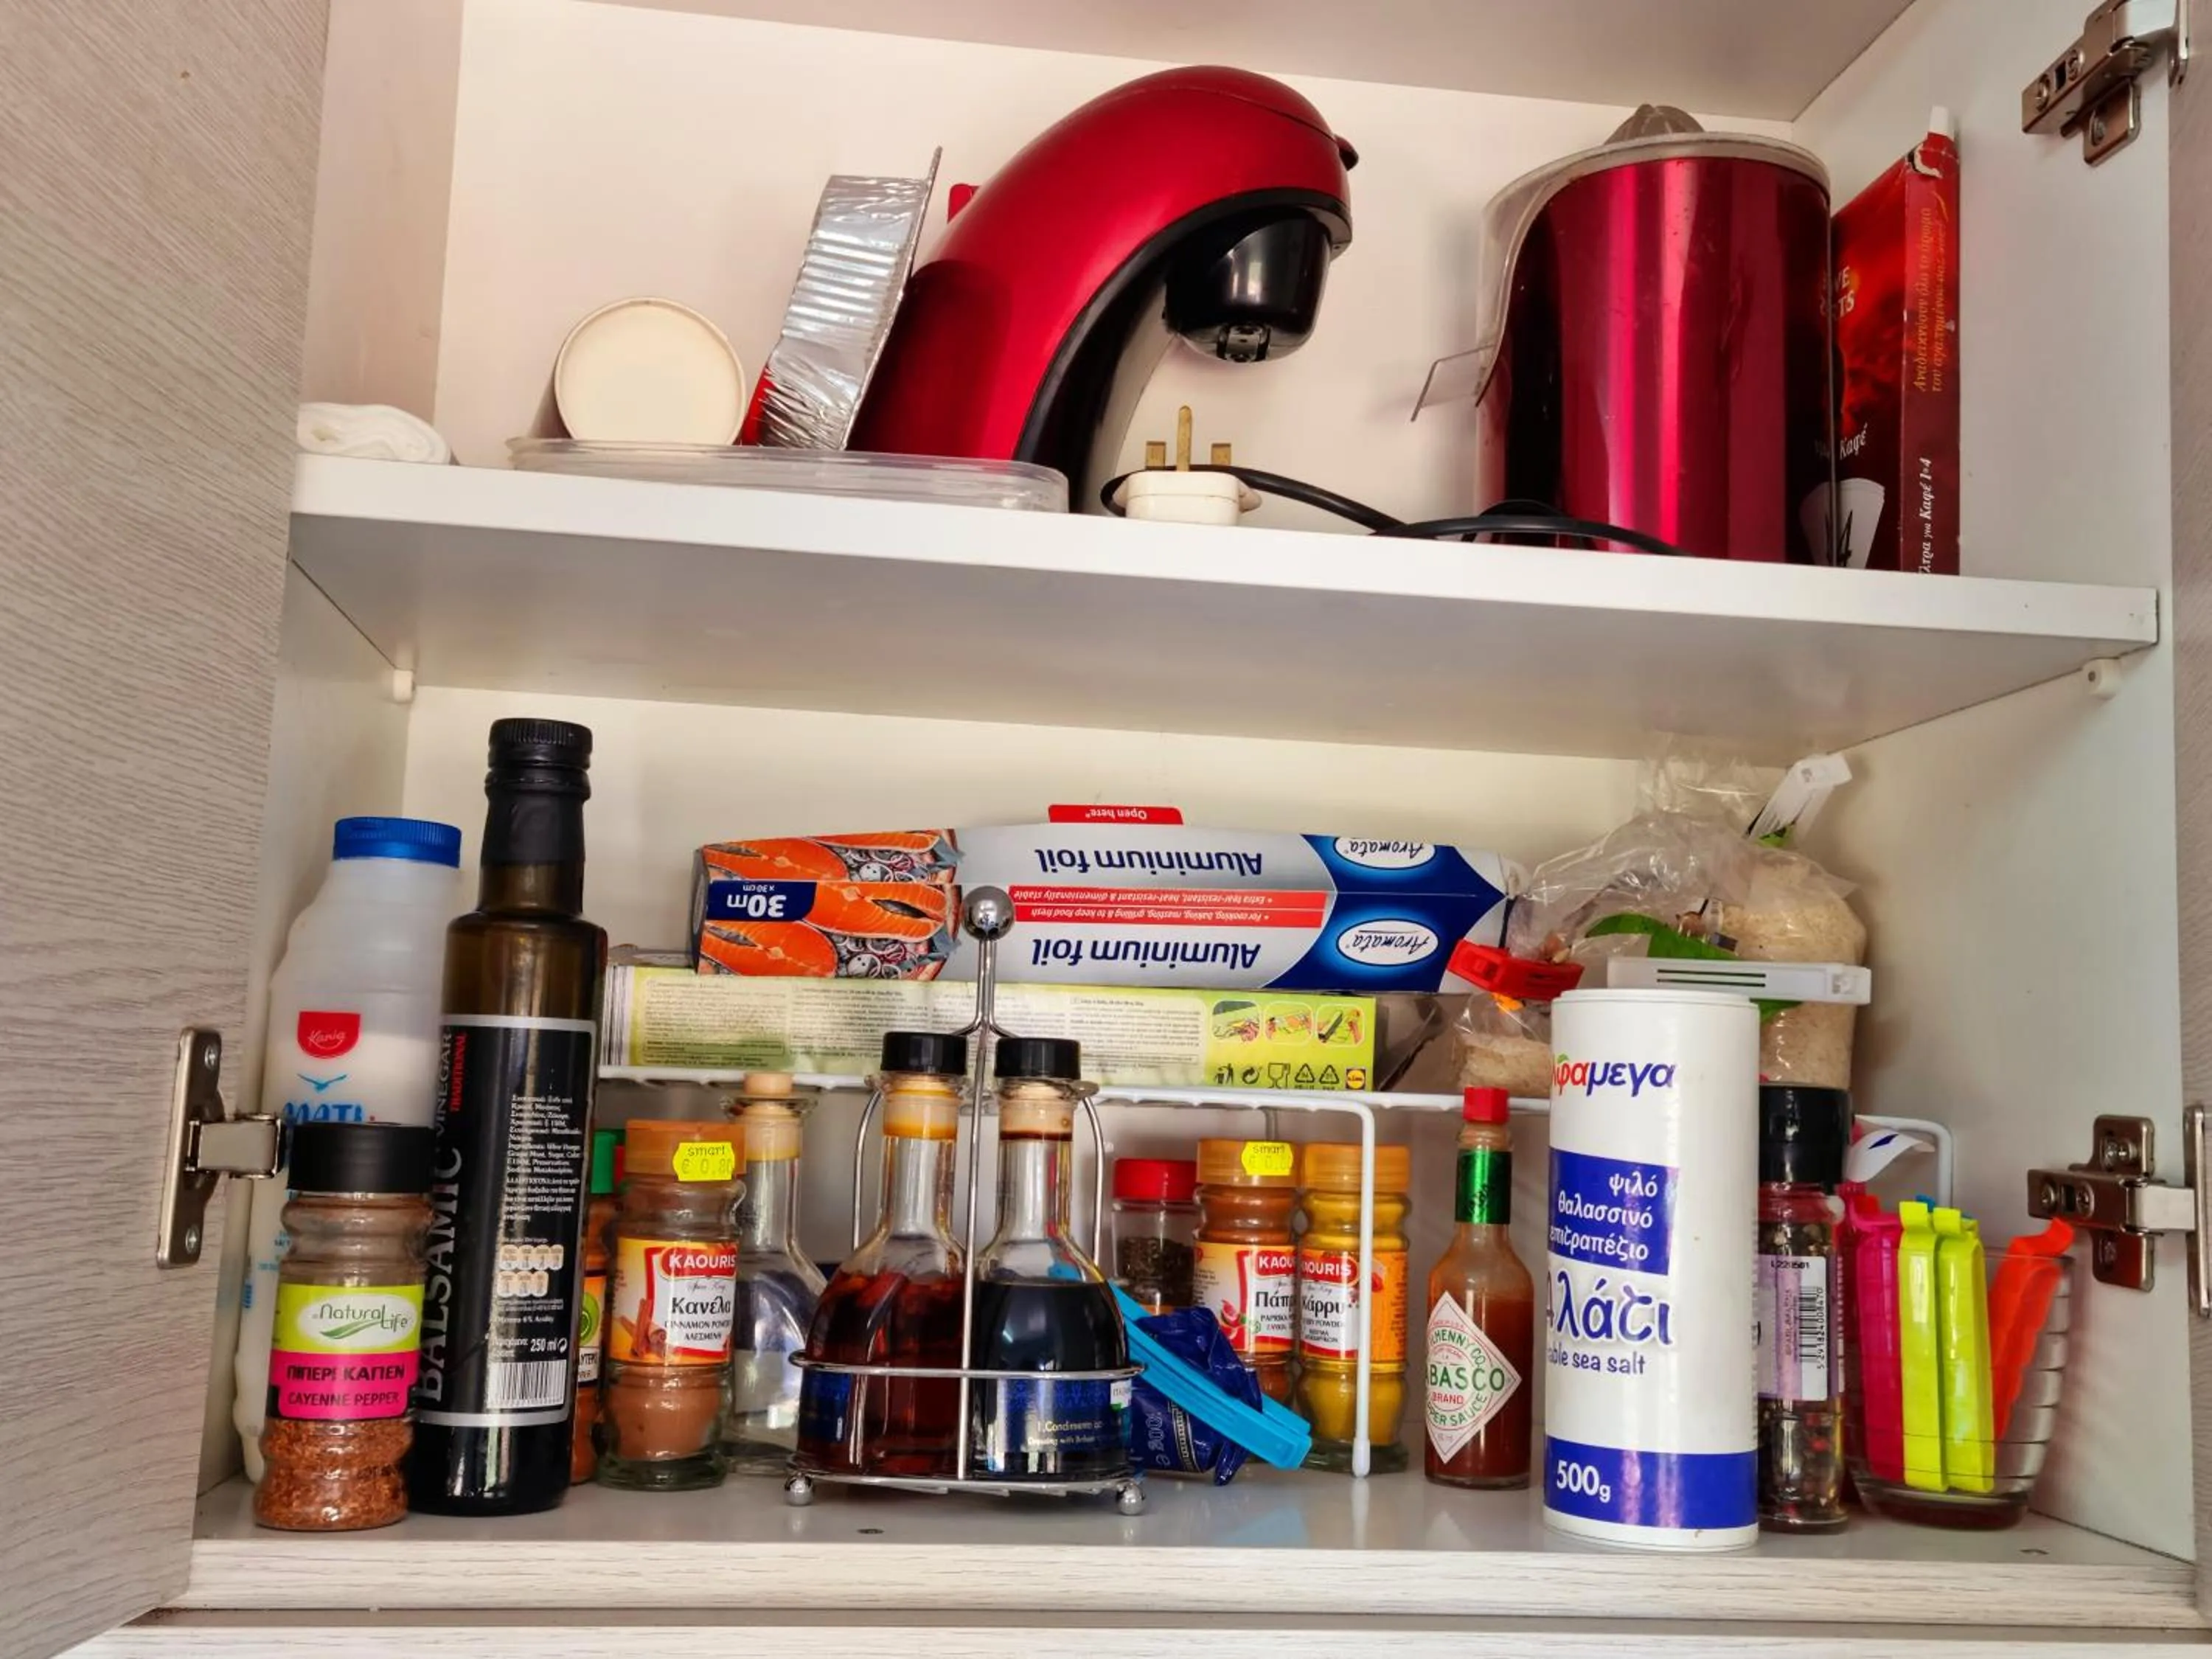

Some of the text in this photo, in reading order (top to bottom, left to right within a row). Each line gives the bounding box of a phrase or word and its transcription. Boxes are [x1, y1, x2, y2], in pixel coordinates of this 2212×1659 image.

[1919, 482, 1935, 521] Καφέ
[1117, 808, 1147, 820] Open
[1349, 839, 1424, 859] Aromata
[1034, 849, 1262, 877] Aluminium foil
[756, 885, 768, 893] 30
[1014, 889, 1042, 900] stable
[1044, 889, 1108, 901] dimensionally
[726, 894, 787, 918] 30m
[1031, 908, 1053, 917] fresh
[1054, 908, 1074, 917] food
[1074, 908, 1096, 918] keep
[1032, 938, 1262, 970] Aluminium foil
[1352, 933, 1430, 956] Aromata
[450, 1032, 467, 1111] TRADITIONAL
[687, 1144, 726, 1158] smart
[1608, 1171, 1659, 1197] ψιλό
[1558, 1189, 1654, 1228] θαλασσινό
[1549, 1224, 1650, 1262] επιτραπέζιο
[669, 1254, 737, 1269] KAOURIS
[1304, 1261, 1352, 1277] OURIS
[417, 1147, 462, 1402] BALSAMIC
[530, 1338, 546, 1352] 250
[547, 1337, 558, 1352] ml
[1572, 1352, 1601, 1371] sea
[1606, 1351, 1646, 1374] salt
[1427, 1363, 1506, 1392] BASCO
[288, 1391, 399, 1407] CAYENNE PEPPER
[1433, 1391, 1464, 1405] BRAND
[1450, 1393, 1487, 1427] SAUCE
[1556, 1459, 1611, 1503] 500g
